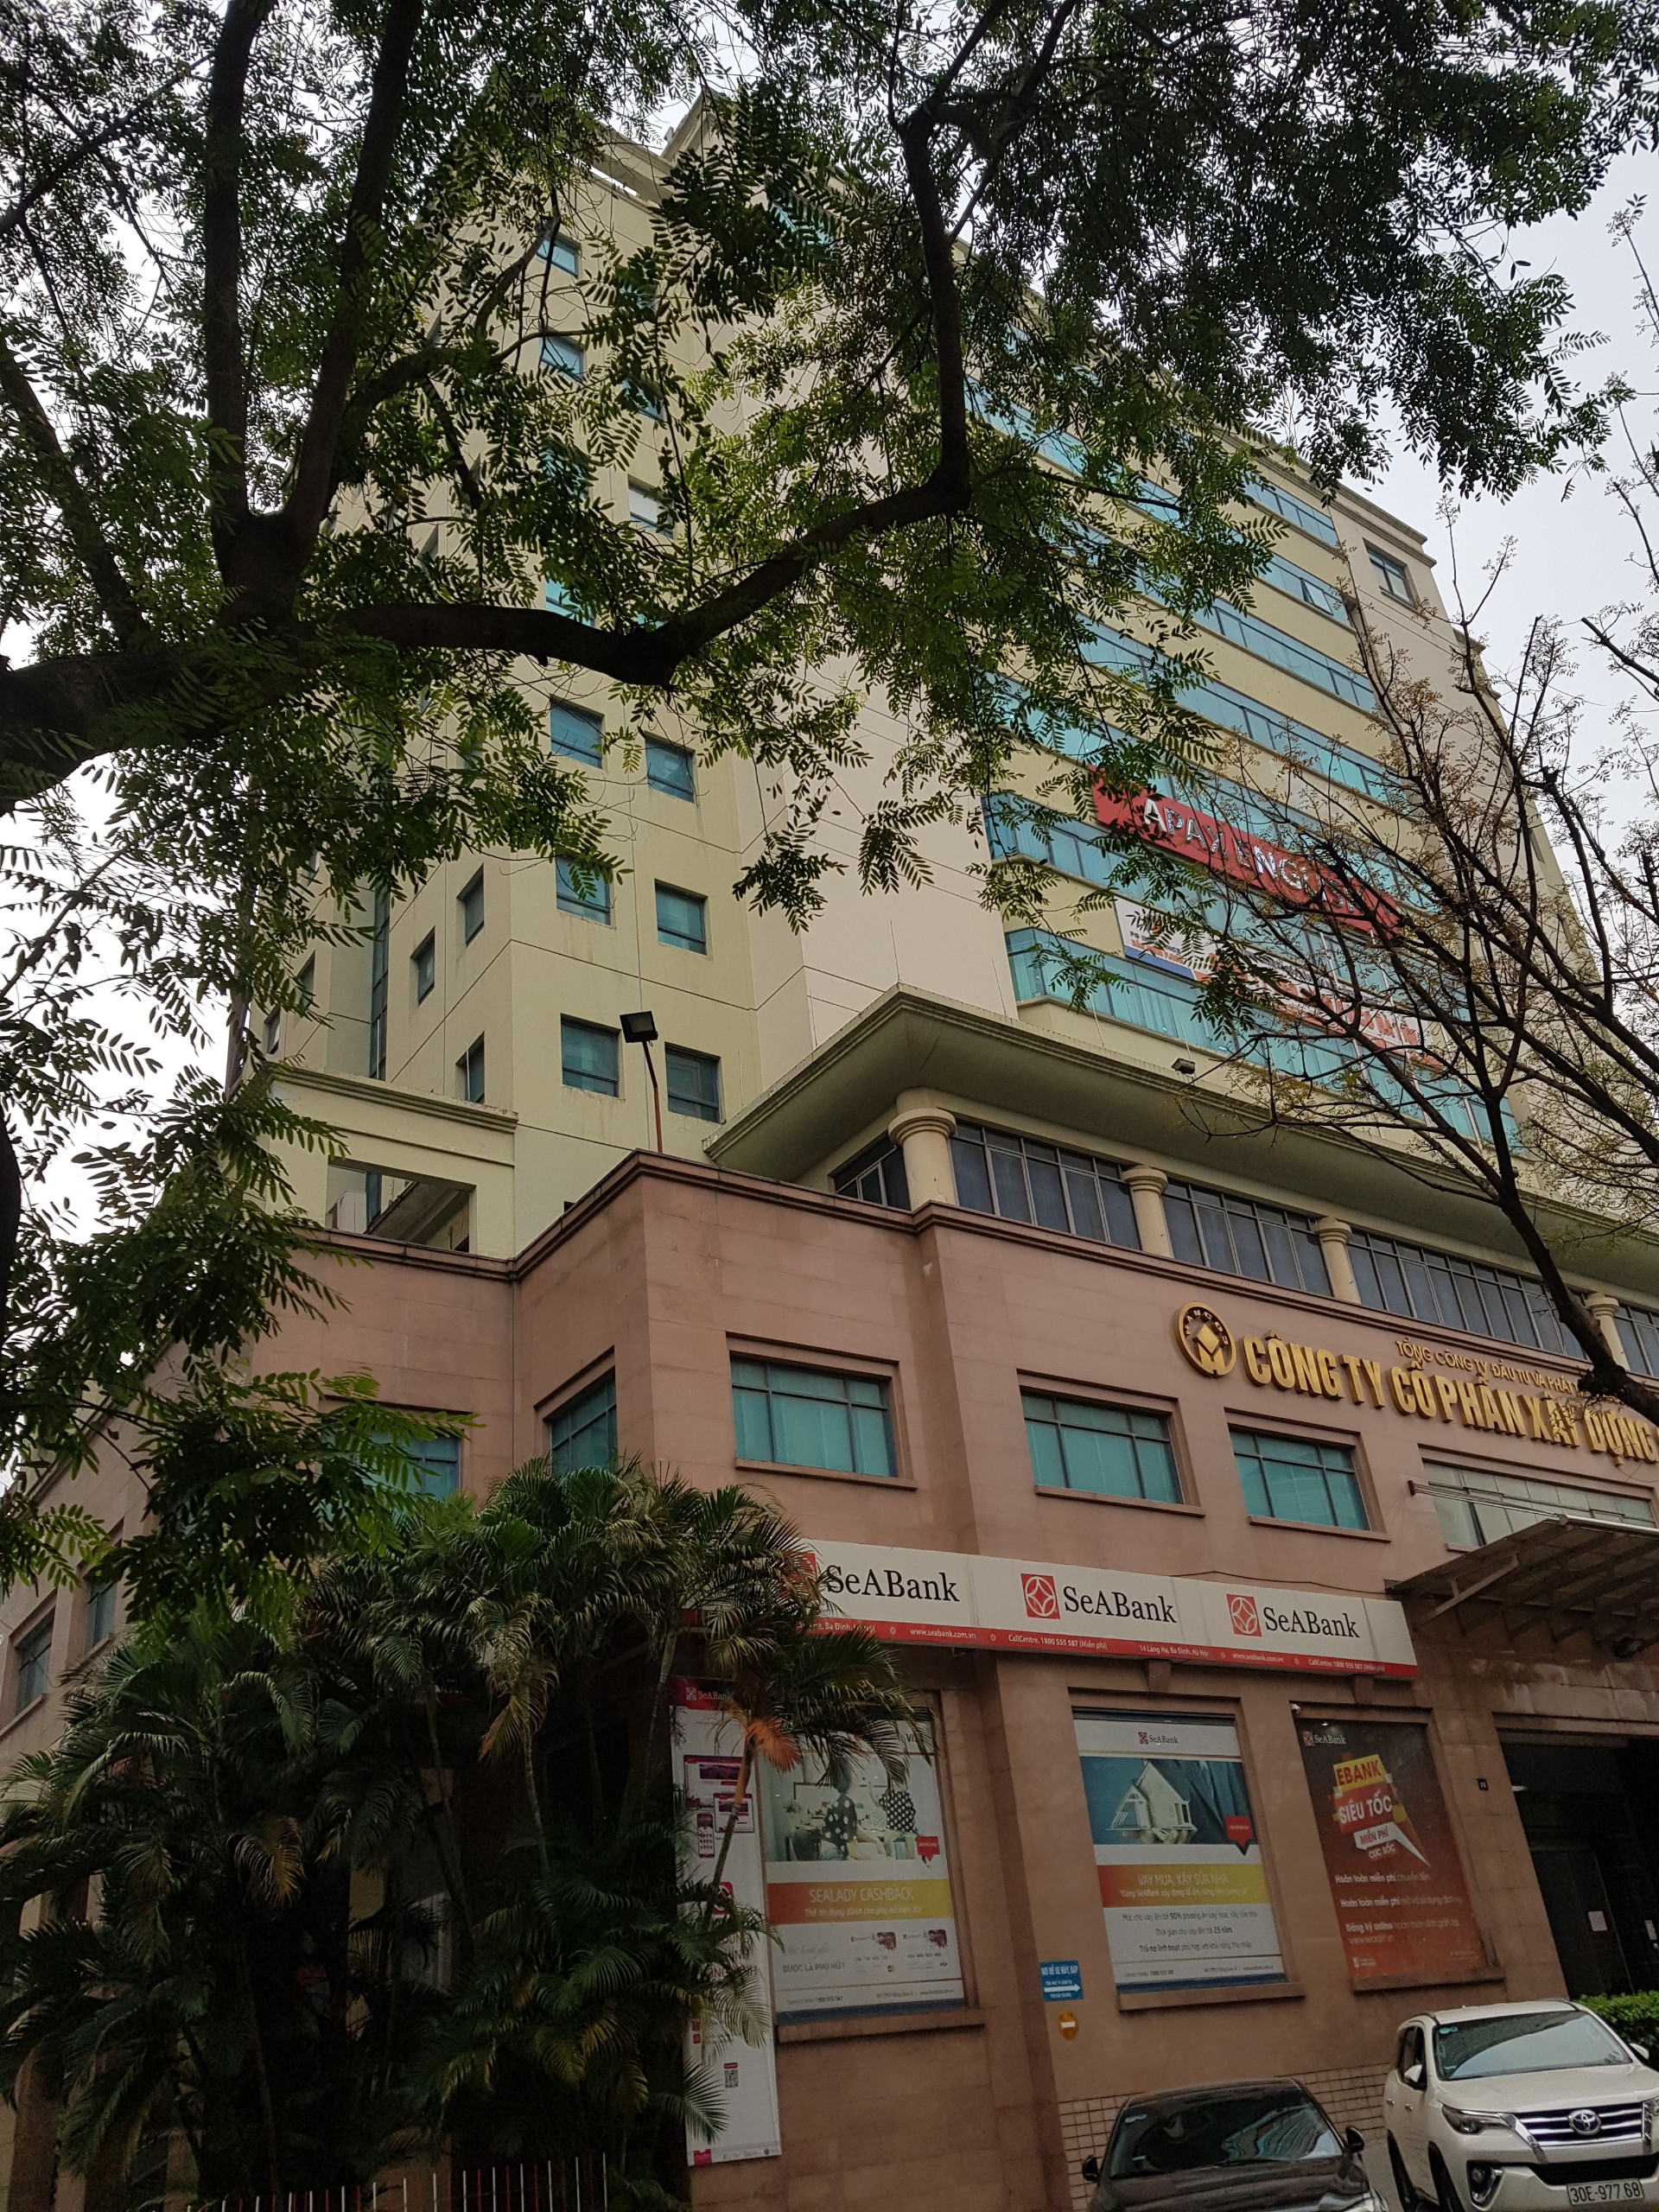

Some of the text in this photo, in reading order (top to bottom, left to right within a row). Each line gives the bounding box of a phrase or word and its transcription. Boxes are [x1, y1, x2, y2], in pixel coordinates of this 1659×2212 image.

[1395, 1338, 1433, 1362] TỔNG
[1435, 1350, 1473, 1371] CÔNG
[1474, 1359, 1488, 1376] TY
[1491, 1359, 1516, 1382] ĐẦU
[1529, 1370, 1547, 1389] VÀ
[1546, 1375, 1573, 1395] PHÁT
[1243, 1329, 1344, 1401] CÔNG
[1338, 1354, 1386, 1409] TY
[1388, 1360, 1438, 1420] CỔ
[1518, 1389, 1580, 1449] XÂY
[827, 1565, 960, 1602] SeABank
[1064, 1586, 1178, 1624] SeABank
[910, 1628, 976, 1640] www.seabank.com.vn
[1263, 1607, 1361, 1638] SeABank
[1040, 1637, 1055, 1645] 1800
[1067, 1638, 1078, 1648] 587
[1314, 1734, 1346, 1745] SeABank
[1337, 1759, 1382, 1786] EBANK
[1338, 1789, 1392, 1824] SIÊU TỐC
[1360, 1827, 1389, 1846] MIỄN PHÍ
[1138, 1874, 1154, 1885] VAY
[810, 1887, 914, 1903] SEALADY CASHBACK
[1373, 1922, 1393, 1930] online
